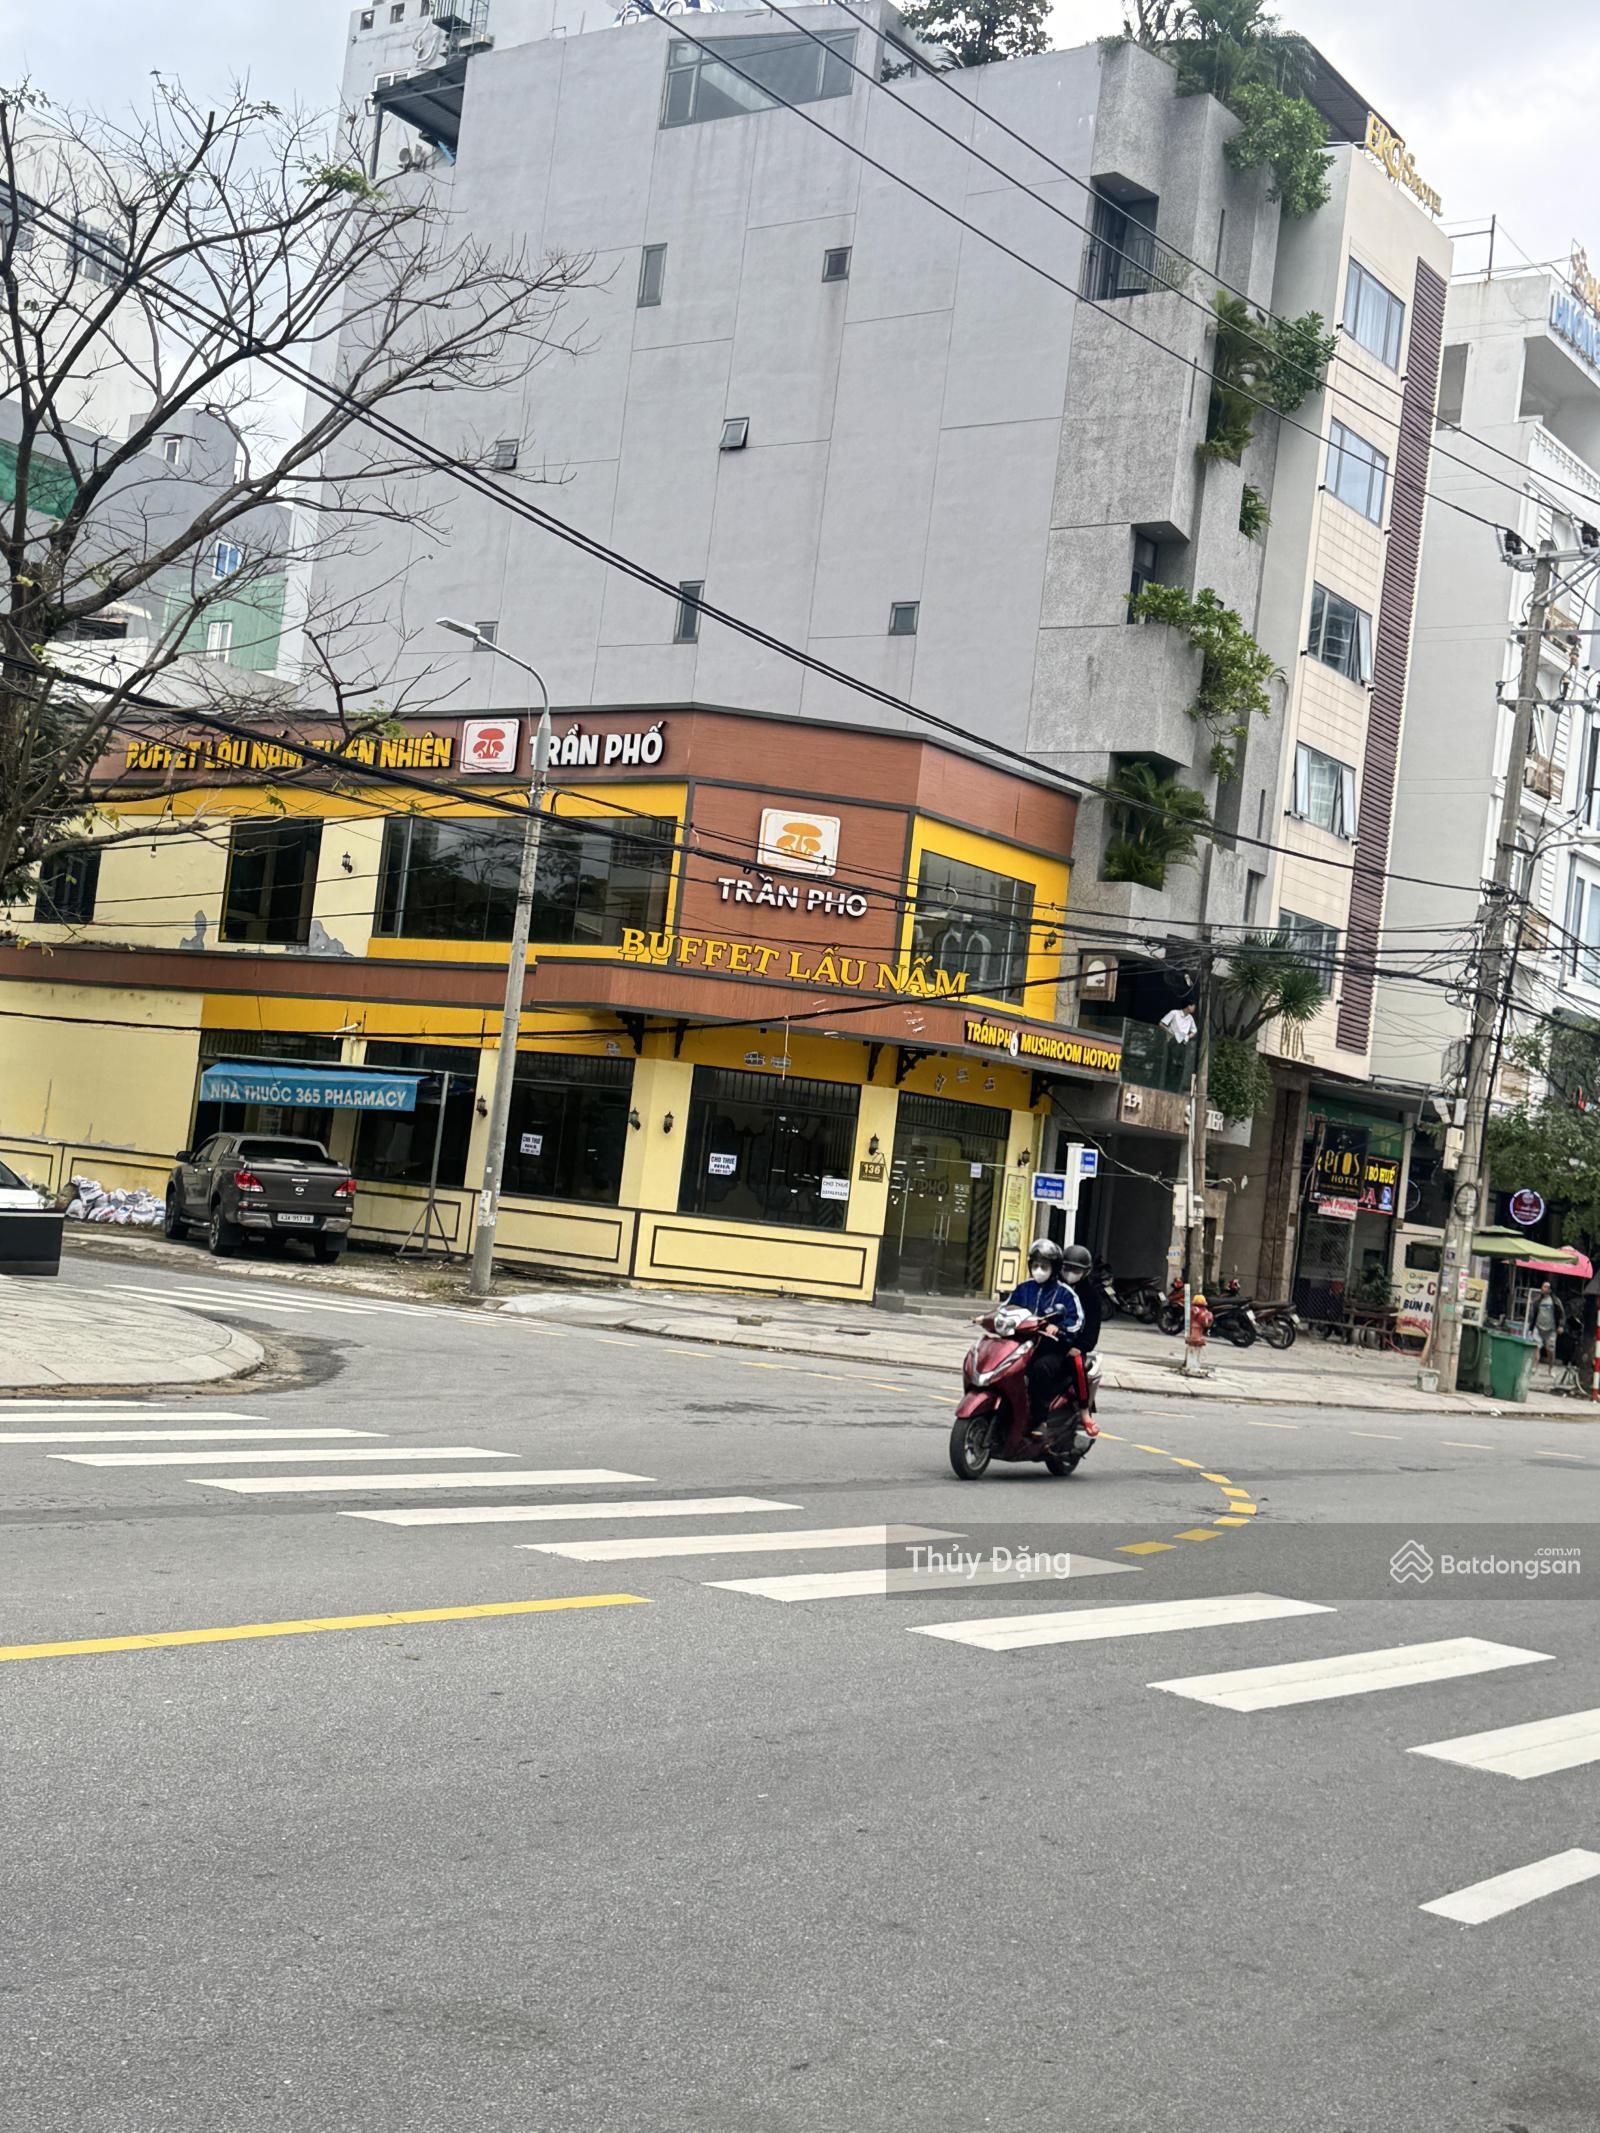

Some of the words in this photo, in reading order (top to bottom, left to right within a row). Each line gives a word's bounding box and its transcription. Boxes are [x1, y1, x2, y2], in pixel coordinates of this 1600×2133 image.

[379, 732, 454, 768] NHIÊN
[603, 720, 666, 765] PHỐ
[618, 926, 780, 976] BUFFET
[873, 954, 970, 998] NẤM
[1019, 1032, 1082, 1064] MUSHROOM
[1081, 1047, 1122, 1072] HOTPOT
[243, 1080, 293, 1103] THUỐC
[295, 1087, 321, 1105] 365
[324, 1089, 408, 1108] PHARMACY
[863, 1163, 881, 1175] 136
[1331, 1174, 1360, 1187] HOTEL
